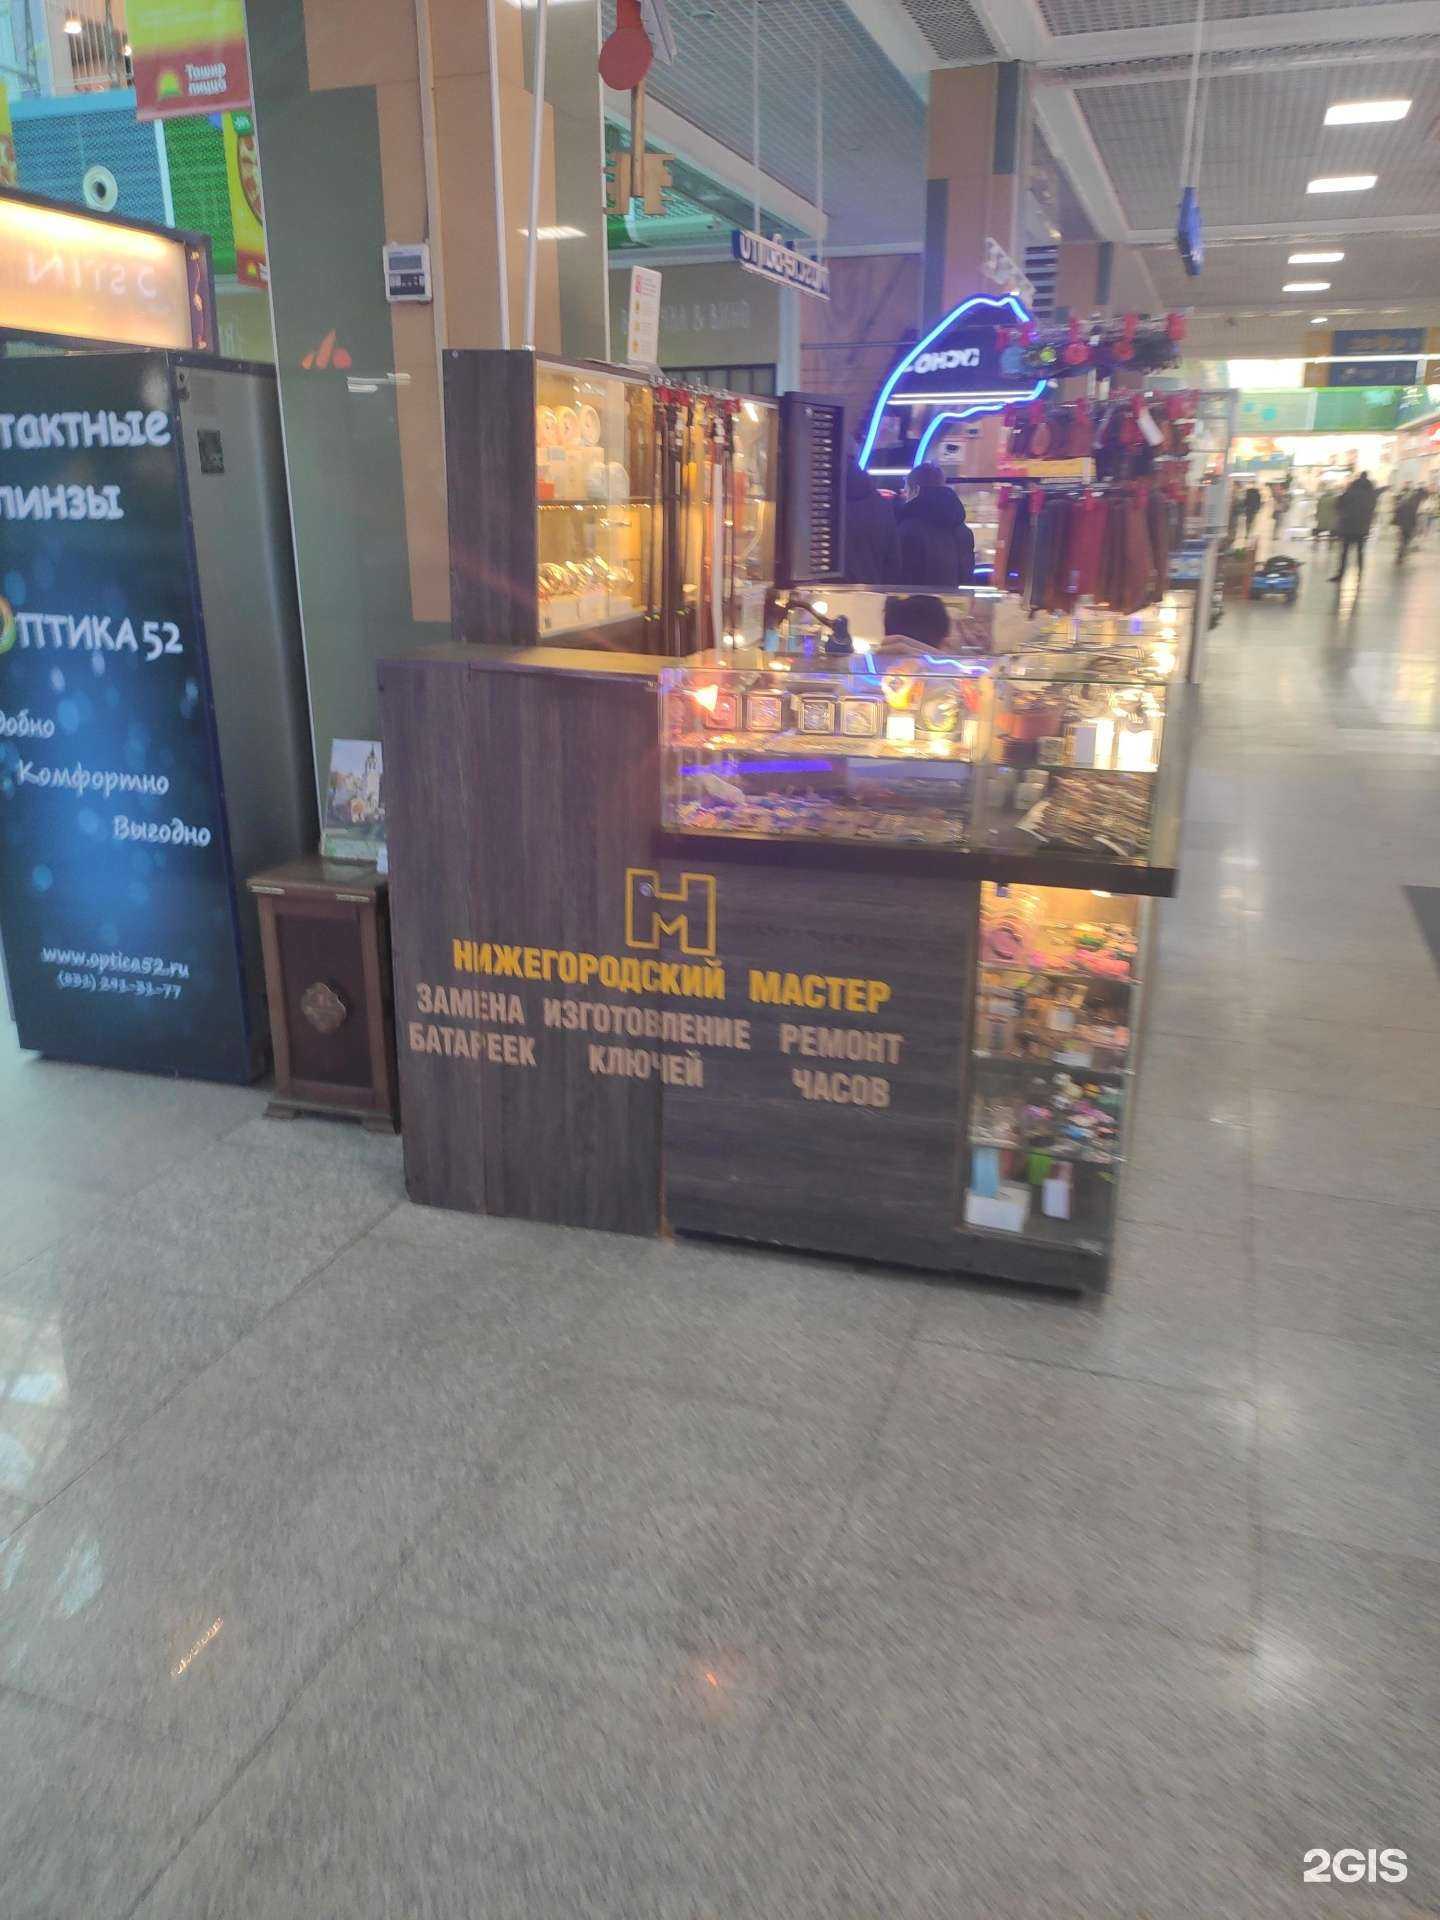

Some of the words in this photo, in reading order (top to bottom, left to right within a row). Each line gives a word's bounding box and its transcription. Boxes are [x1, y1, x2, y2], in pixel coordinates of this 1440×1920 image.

[19, 760, 170, 797] Комфортно
[113, 814, 212, 847] Выгодно
[42, 947, 189, 977] www.optica52.ru
[452, 938, 726, 1000] НИЖЕГОРОДСКИЙ
[748, 969, 893, 1014] МАСТЕР
[416, 982, 526, 1026] ЗАМЕНА
[543, 997, 752, 1051] ИЗГОТОВЛЕНИЕ
[408, 1021, 538, 1068] БАТАРЕЕК
[588, 1043, 704, 1089] КЛЮЧЕЙ
[779, 1023, 905, 1066] РЕМОНТ
[792, 1066, 892, 1110] ЧАСОВ
